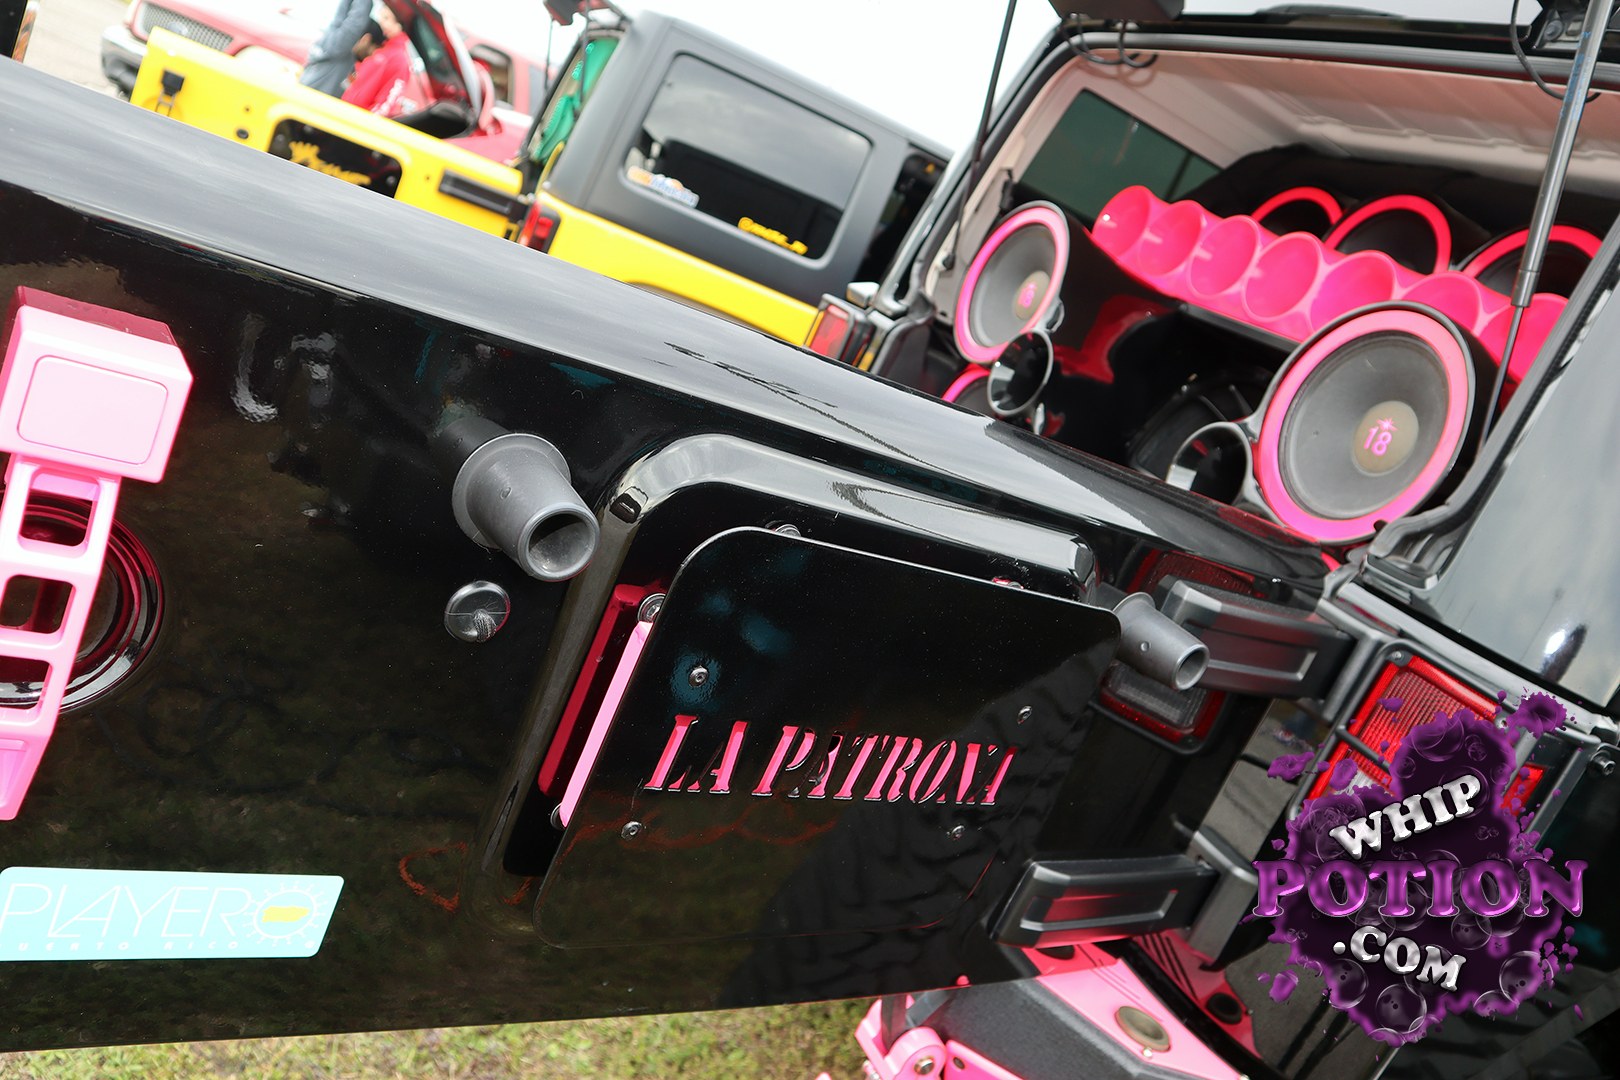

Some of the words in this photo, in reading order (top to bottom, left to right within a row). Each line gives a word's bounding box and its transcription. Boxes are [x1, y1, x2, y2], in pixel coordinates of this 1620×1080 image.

[1363, 427, 1393, 456] 18
[643, 714, 747, 793] LA
[751, 725, 1018, 805] PATRONA
